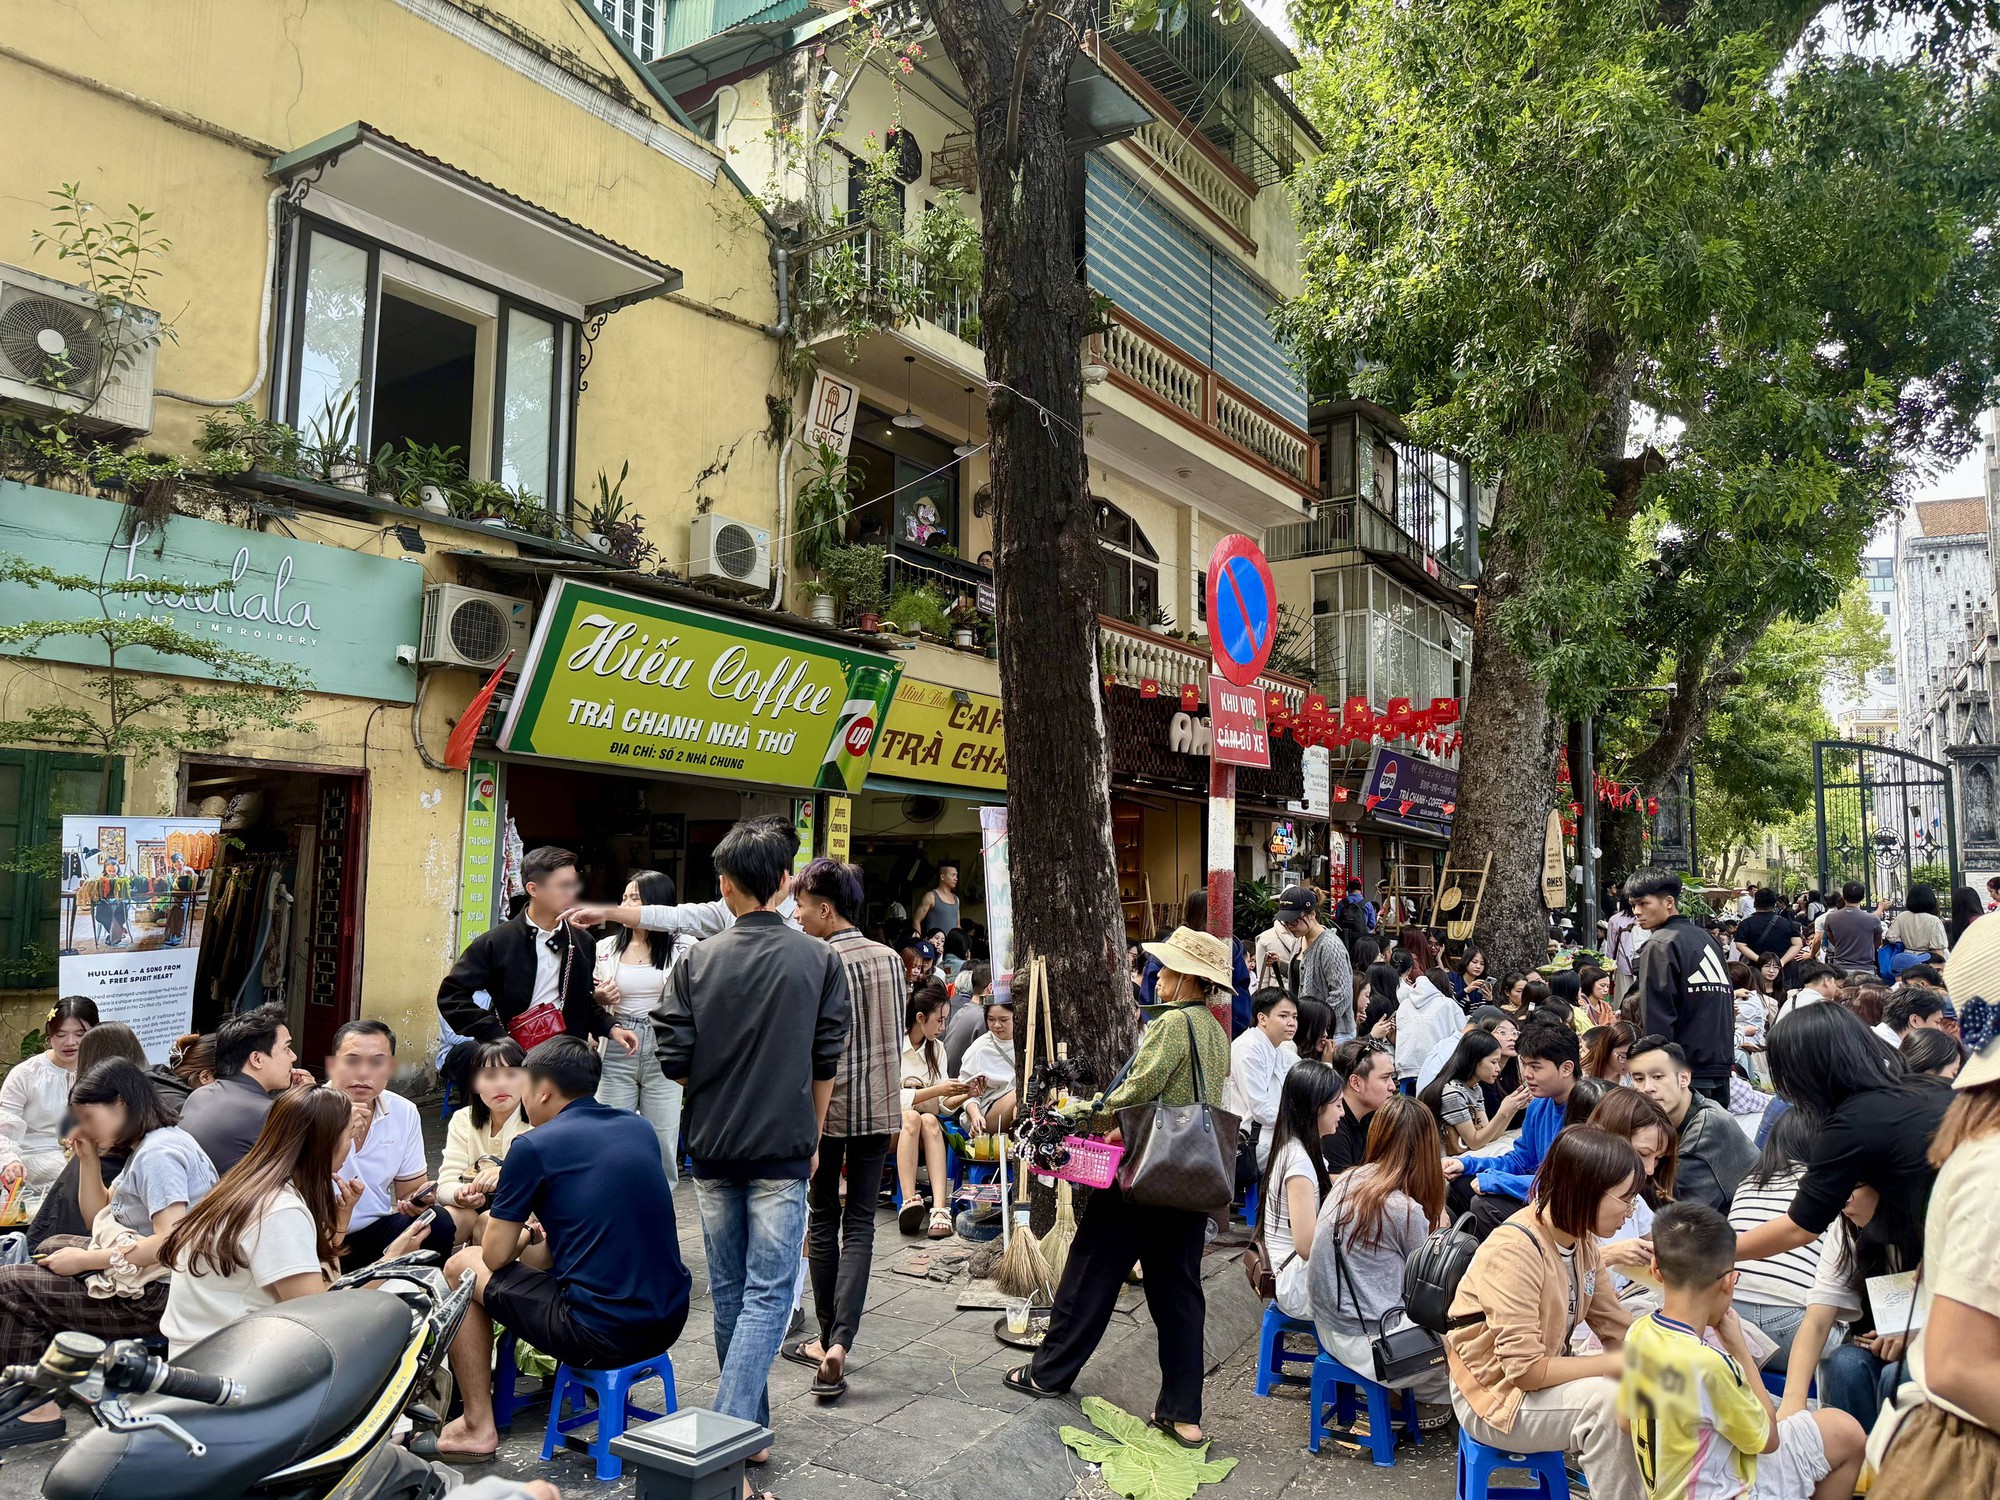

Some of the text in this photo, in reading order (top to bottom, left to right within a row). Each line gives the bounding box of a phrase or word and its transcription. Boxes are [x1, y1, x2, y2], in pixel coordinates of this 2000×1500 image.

[112, 520, 321, 630] huulala
[196, 620, 319, 647] EMBROIDERY
[567, 613, 833, 719] Hiếu Coffee
[895, 684, 925, 702] Minh
[1220, 692, 1257, 720] KHU VỰC
[567, 694, 798, 756] TRÀ CHANH NHÀ THỜ
[948, 702, 1005, 735] CAF
[609, 742, 745, 769] ĐỊA CHỈ: SỐ 2 NHÀ CHUNG
[881, 729, 1007, 775] TRÀ CHA
[1252, 734, 1264, 752] XE
[1381, 775, 1395, 786] PEPSI
[1270, 844, 1287, 853] COFFEE
[87, 969, 129, 977] HUULALA
[357, 1428, 370, 1440] THE
[368, 1405, 388, 1428] BEAUTY
[386, 1396, 395, 1404] OF
[1418, 1413, 1448, 1428] crocs
